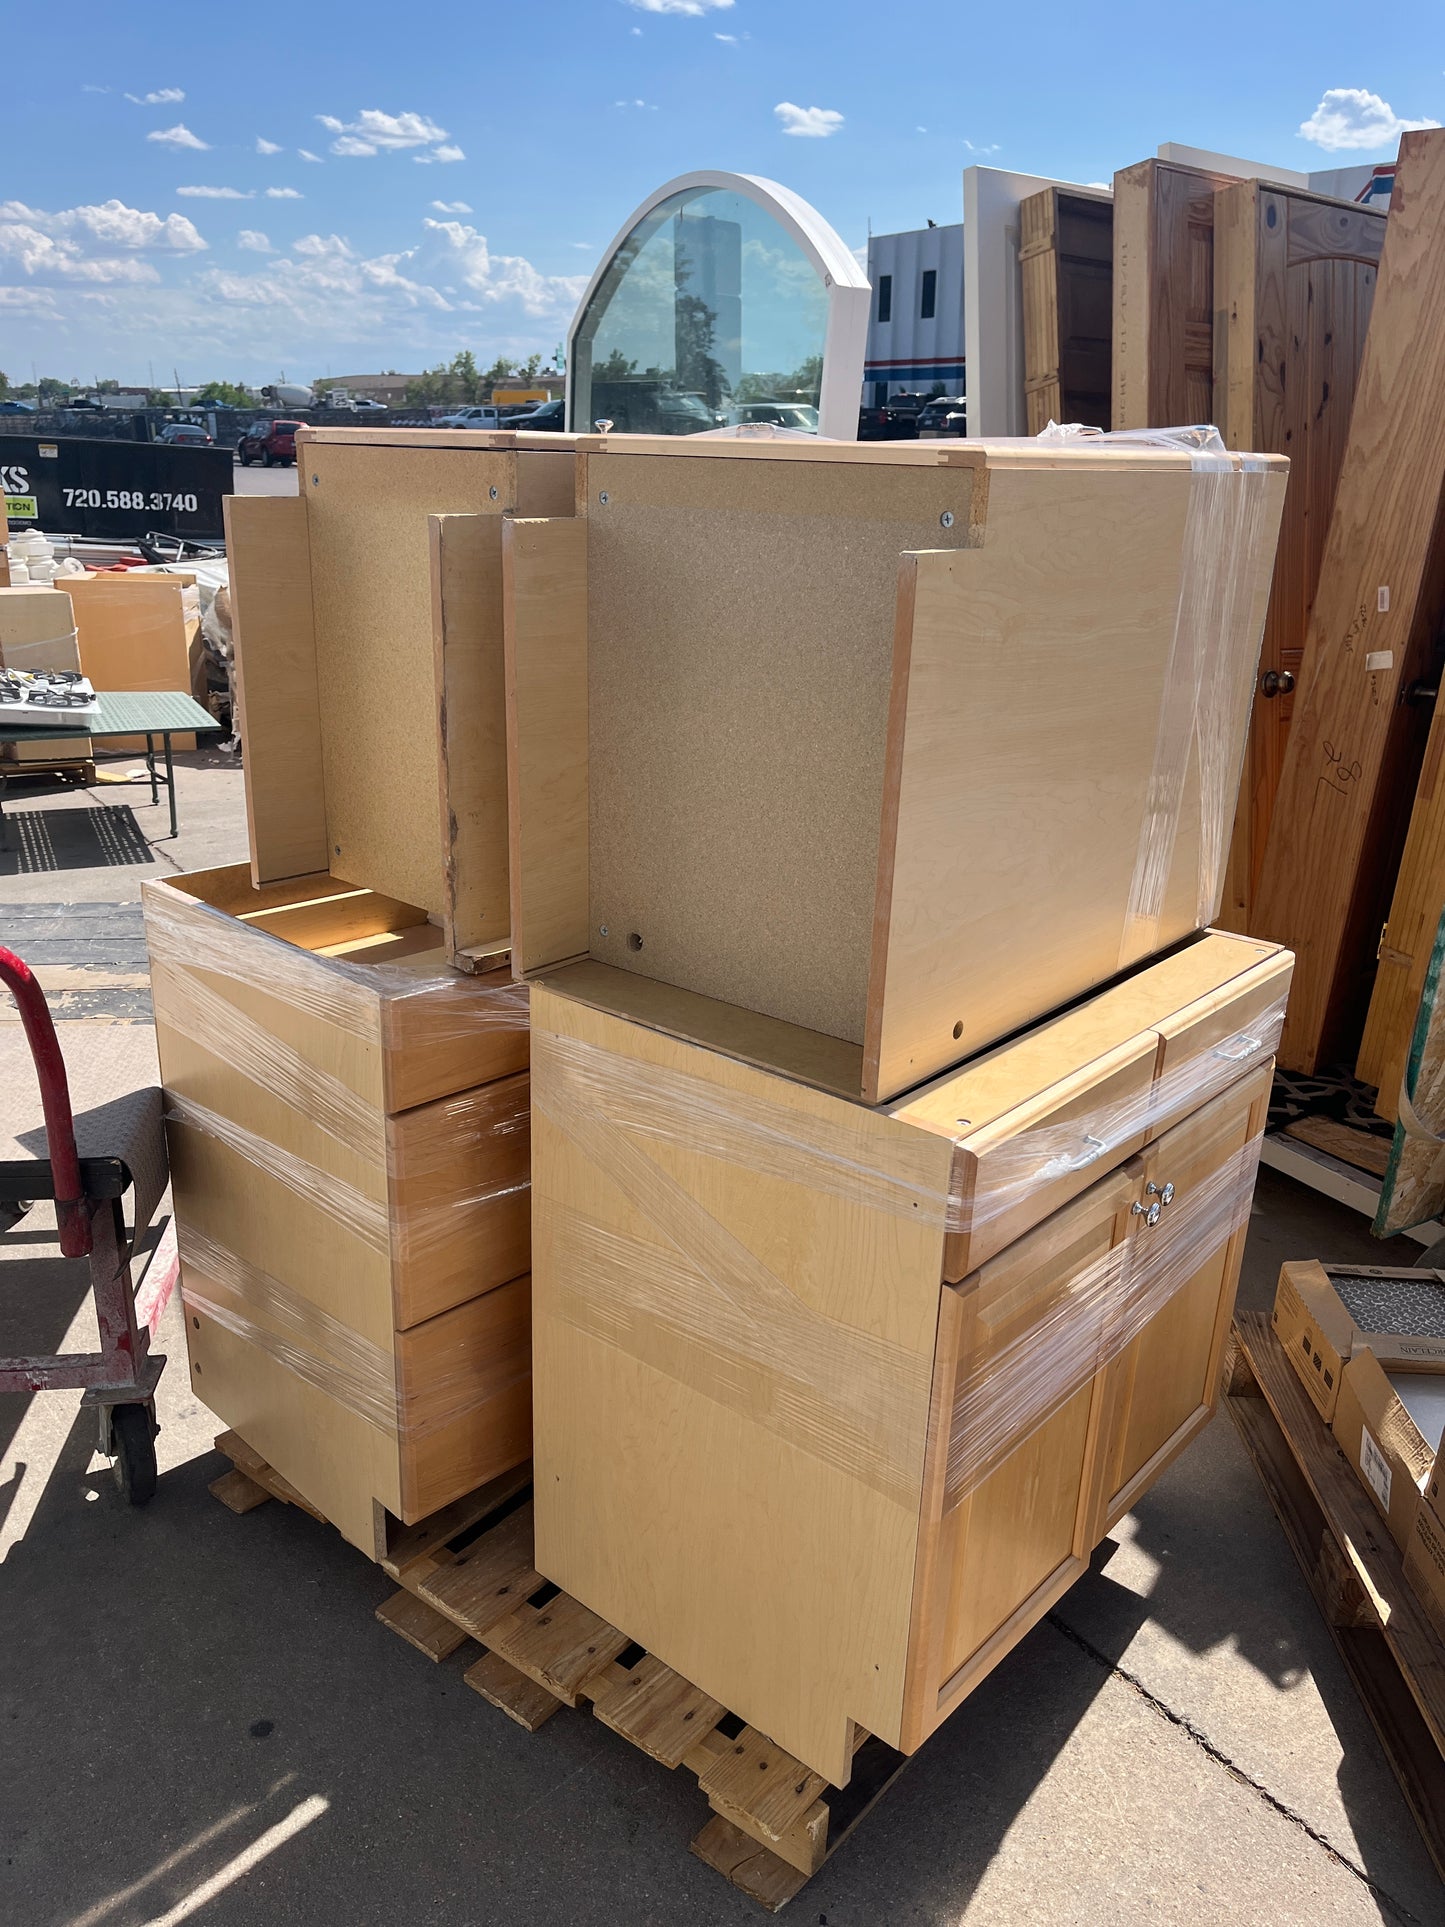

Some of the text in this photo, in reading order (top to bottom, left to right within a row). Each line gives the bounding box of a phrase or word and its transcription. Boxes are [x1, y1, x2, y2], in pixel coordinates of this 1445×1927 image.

[335, 398, 348, 406] 25
[63, 488, 198, 512] 720.588.3740
[1400, 1346, 1445, 1355] RCELAIN
